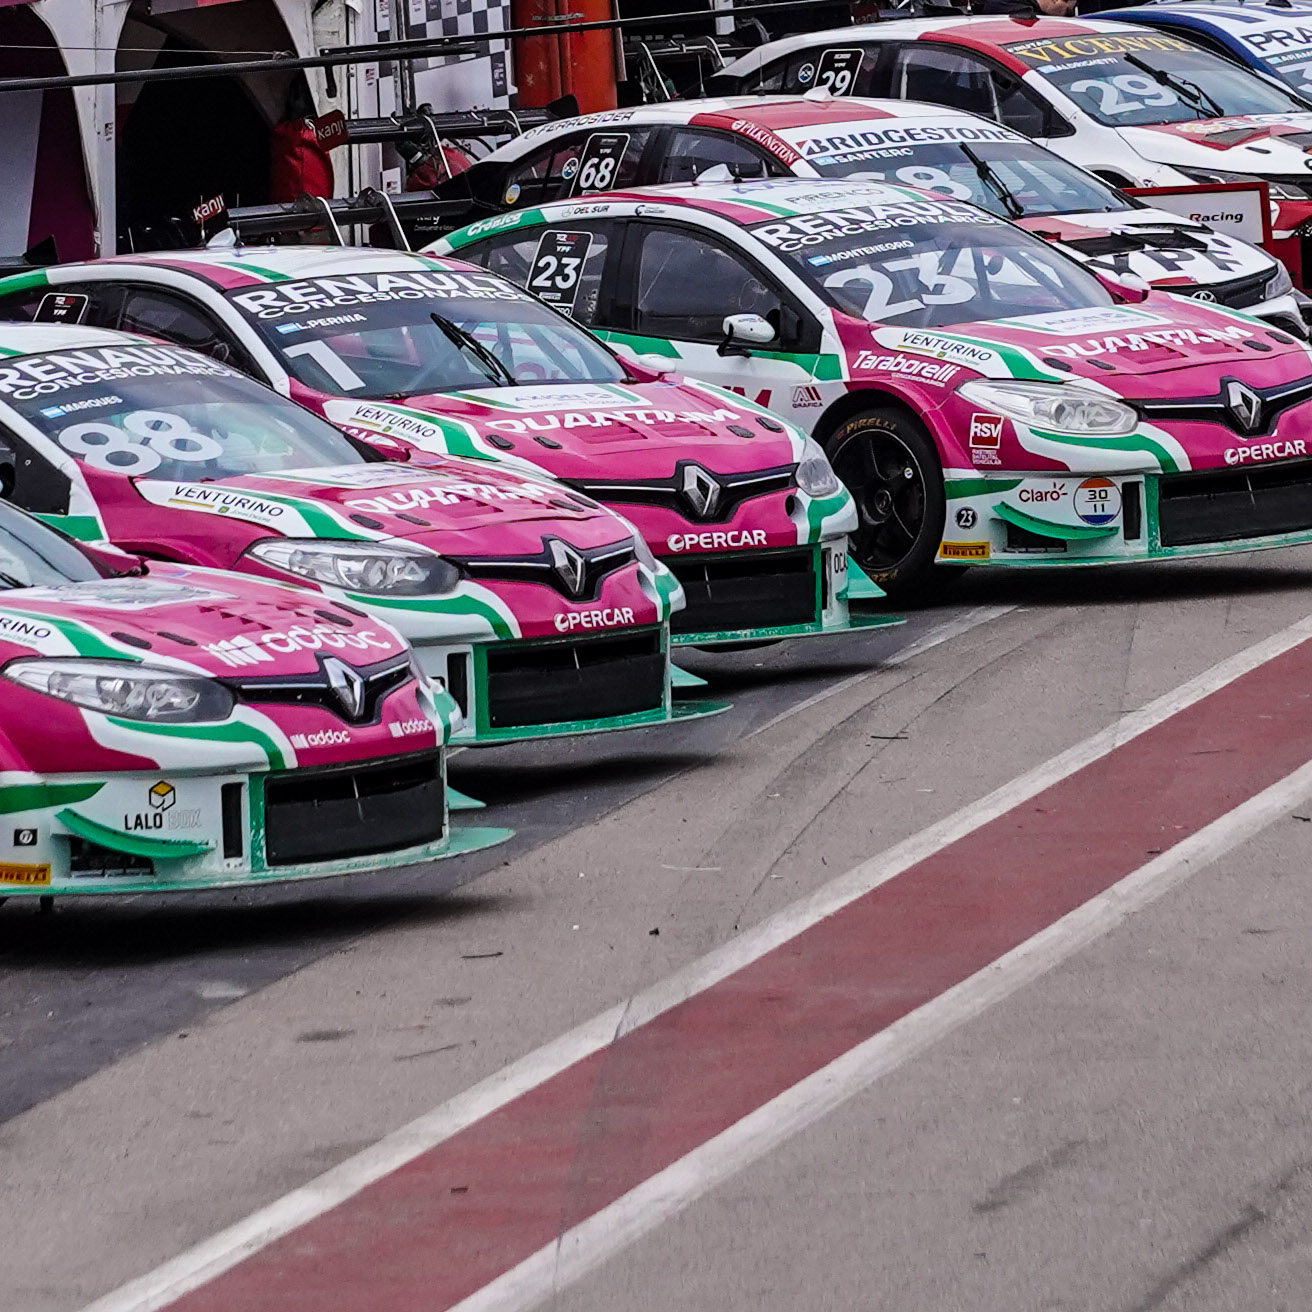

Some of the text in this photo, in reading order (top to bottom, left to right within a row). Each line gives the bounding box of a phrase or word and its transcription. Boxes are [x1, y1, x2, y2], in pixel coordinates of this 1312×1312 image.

[1015, 37, 1200, 63] VICENTE
[1070, 73, 1180, 116] 29
[795, 127, 1016, 159] BRIDGESTONE
[579, 157, 616, 189] 68
[750, 200, 984, 247] RENAULT
[1189, 211, 1244, 223] Racing
[826, 240, 915, 262] MONTENEGRO
[531, 255, 582, 289] 23
[235, 271, 514, 316] RENAULT
[823, 252, 978, 324] 23
[298, 312, 367, 331] L.PERNIA
[901, 331, 993, 363] VENTURINO
[282, 340, 368, 392] 1
[852, 350, 962, 382] Taraborelli
[60, 394, 123, 417] MARQUES
[354, 404, 437, 439] VENTURINO
[845, 417, 897, 435] PIRELLI
[972, 422, 1000, 438] RSV
[58, 410, 224, 476] 88
[173, 485, 285, 518] VENTURINO
[1019, 489, 1062, 504] Claro
[1088, 490, 1108, 500] 30
[959, 511, 975, 527] 23
[1092, 504, 1106, 514] 11
[942, 544, 987, 557] PIRELLI
[306, 728, 352, 746] addoc
[400, 717, 435, 735] addoc
[124, 811, 164, 832] LALO
